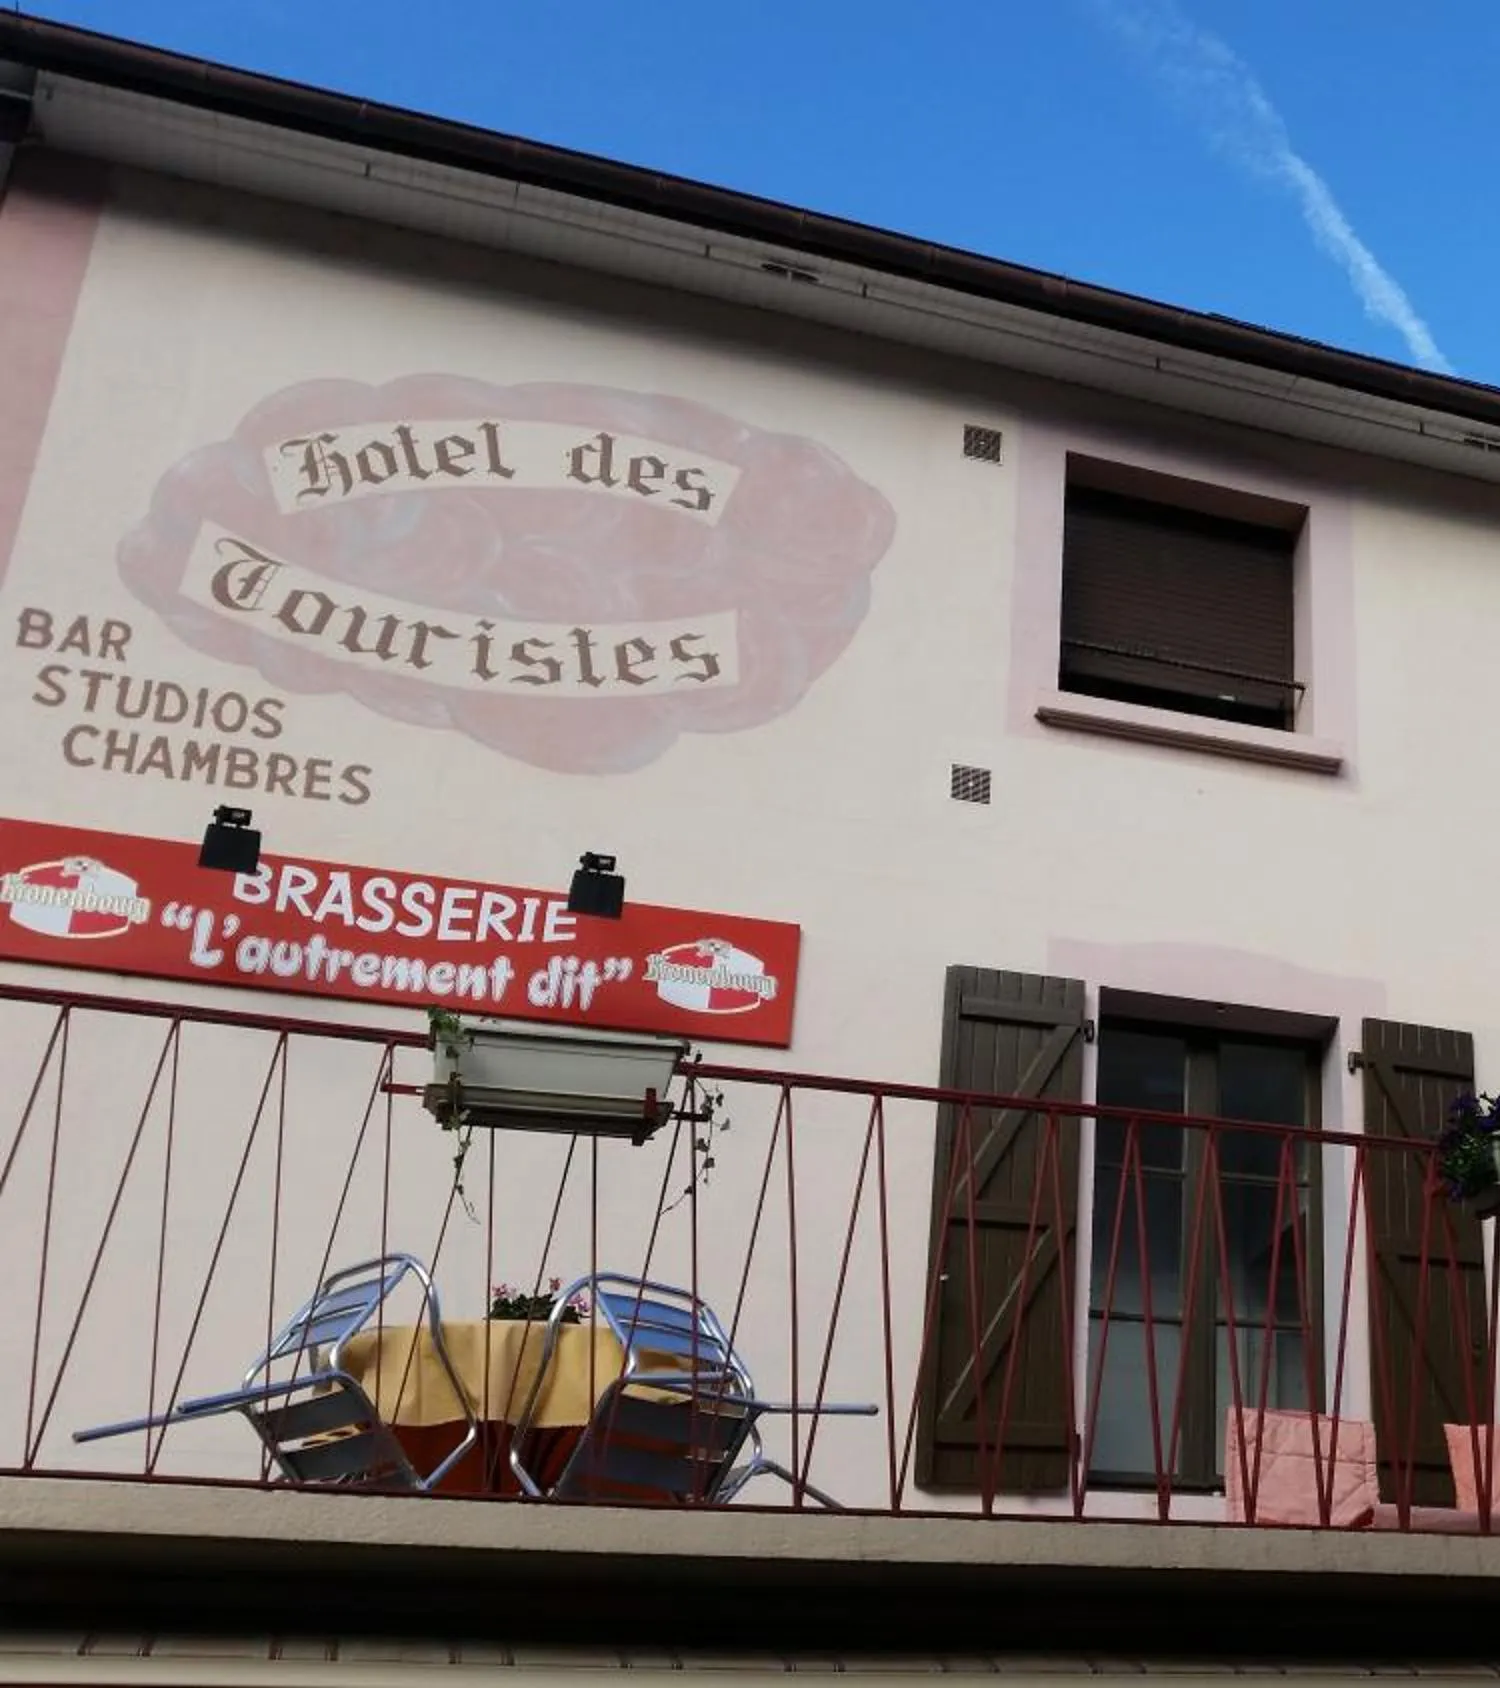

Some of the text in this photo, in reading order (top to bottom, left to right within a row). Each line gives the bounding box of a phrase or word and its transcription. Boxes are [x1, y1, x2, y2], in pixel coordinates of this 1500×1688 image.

[279, 421, 717, 513] Hotel des
[16, 607, 133, 661] BAR
[210, 537, 721, 688] Touristes
[33, 665, 285, 739] STUDIOS
[62, 724, 372, 806] CHAMBRES
[232, 863, 577, 943] BRASSERIE
